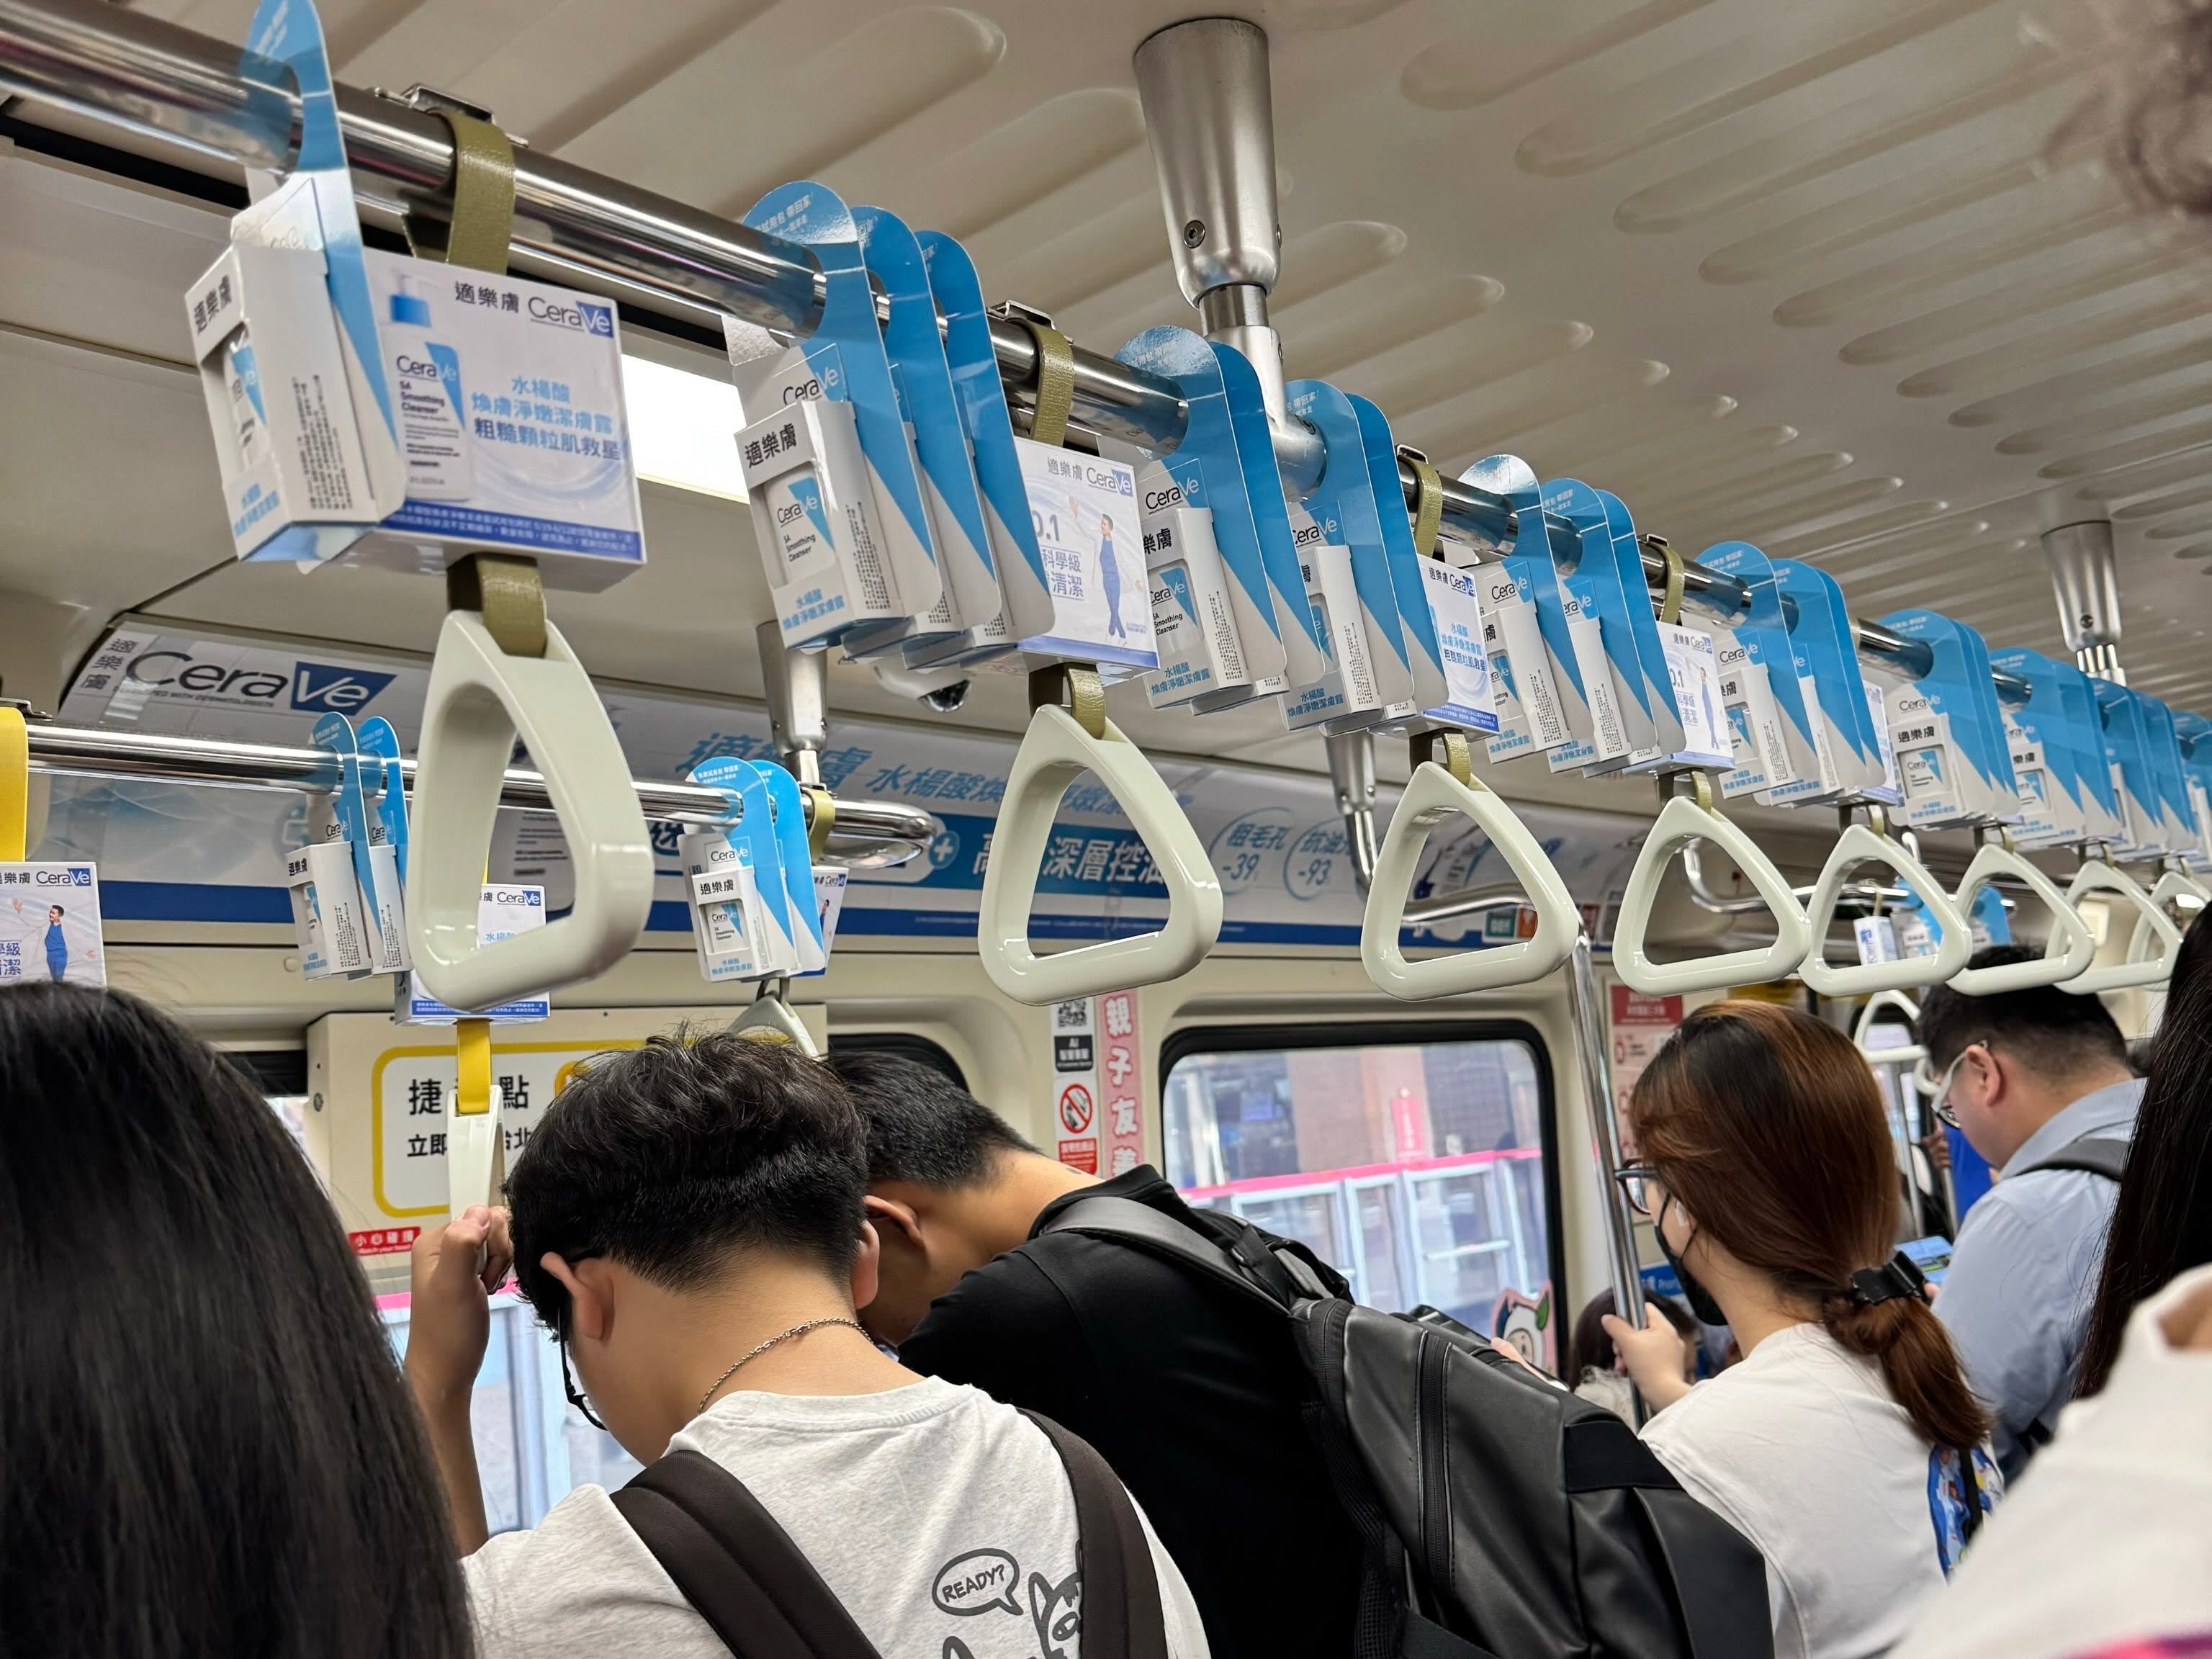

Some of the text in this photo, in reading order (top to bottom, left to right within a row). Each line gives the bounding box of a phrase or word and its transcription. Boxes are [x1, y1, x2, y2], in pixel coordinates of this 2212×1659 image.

[455, 280, 612, 334] 適樂膚 CeraVe
[396, 355, 457, 380] CeraVe
[511, 374, 570, 403] 水楊酸
[783, 367, 839, 405] CeraVe
[475, 416, 621, 461] 粗糙顆粒肌救星
[745, 423, 797, 469] 適樂膚
[1048, 457, 1133, 494] 適樂膚 CeraVe
[1146, 477, 1200, 510] CeraVe
[777, 495, 818, 523] CeraVe
[786, 534, 816, 553] Smoothing
[1143, 528, 1172, 554] 樂膚
[788, 546, 811, 562] Cleanser
[1046, 571, 1084, 598] 清潔
[1449, 574, 1475, 596] CeraVe
[1491, 576, 1528, 600] CeraVe
[1154, 613, 1183, 628] Smoothing
[1156, 623, 1179, 636] Cleanser
[1719, 642, 1758, 663] CeraVe
[126, 651, 371, 709] CeraVe
[1164, 662, 1190, 678] 水楊酸
[1899, 694, 1941, 712] CeraVe
[2012, 752, 2036, 765] 樂膚
[711, 848, 748, 862] CeraVe
[0, 870, 91, 885] 樂膚 CeraVe
[701, 879, 734, 895] 適樂膚
[497, 891, 541, 904] CeraVe
[942, 1563, 1005, 1603] READY?
